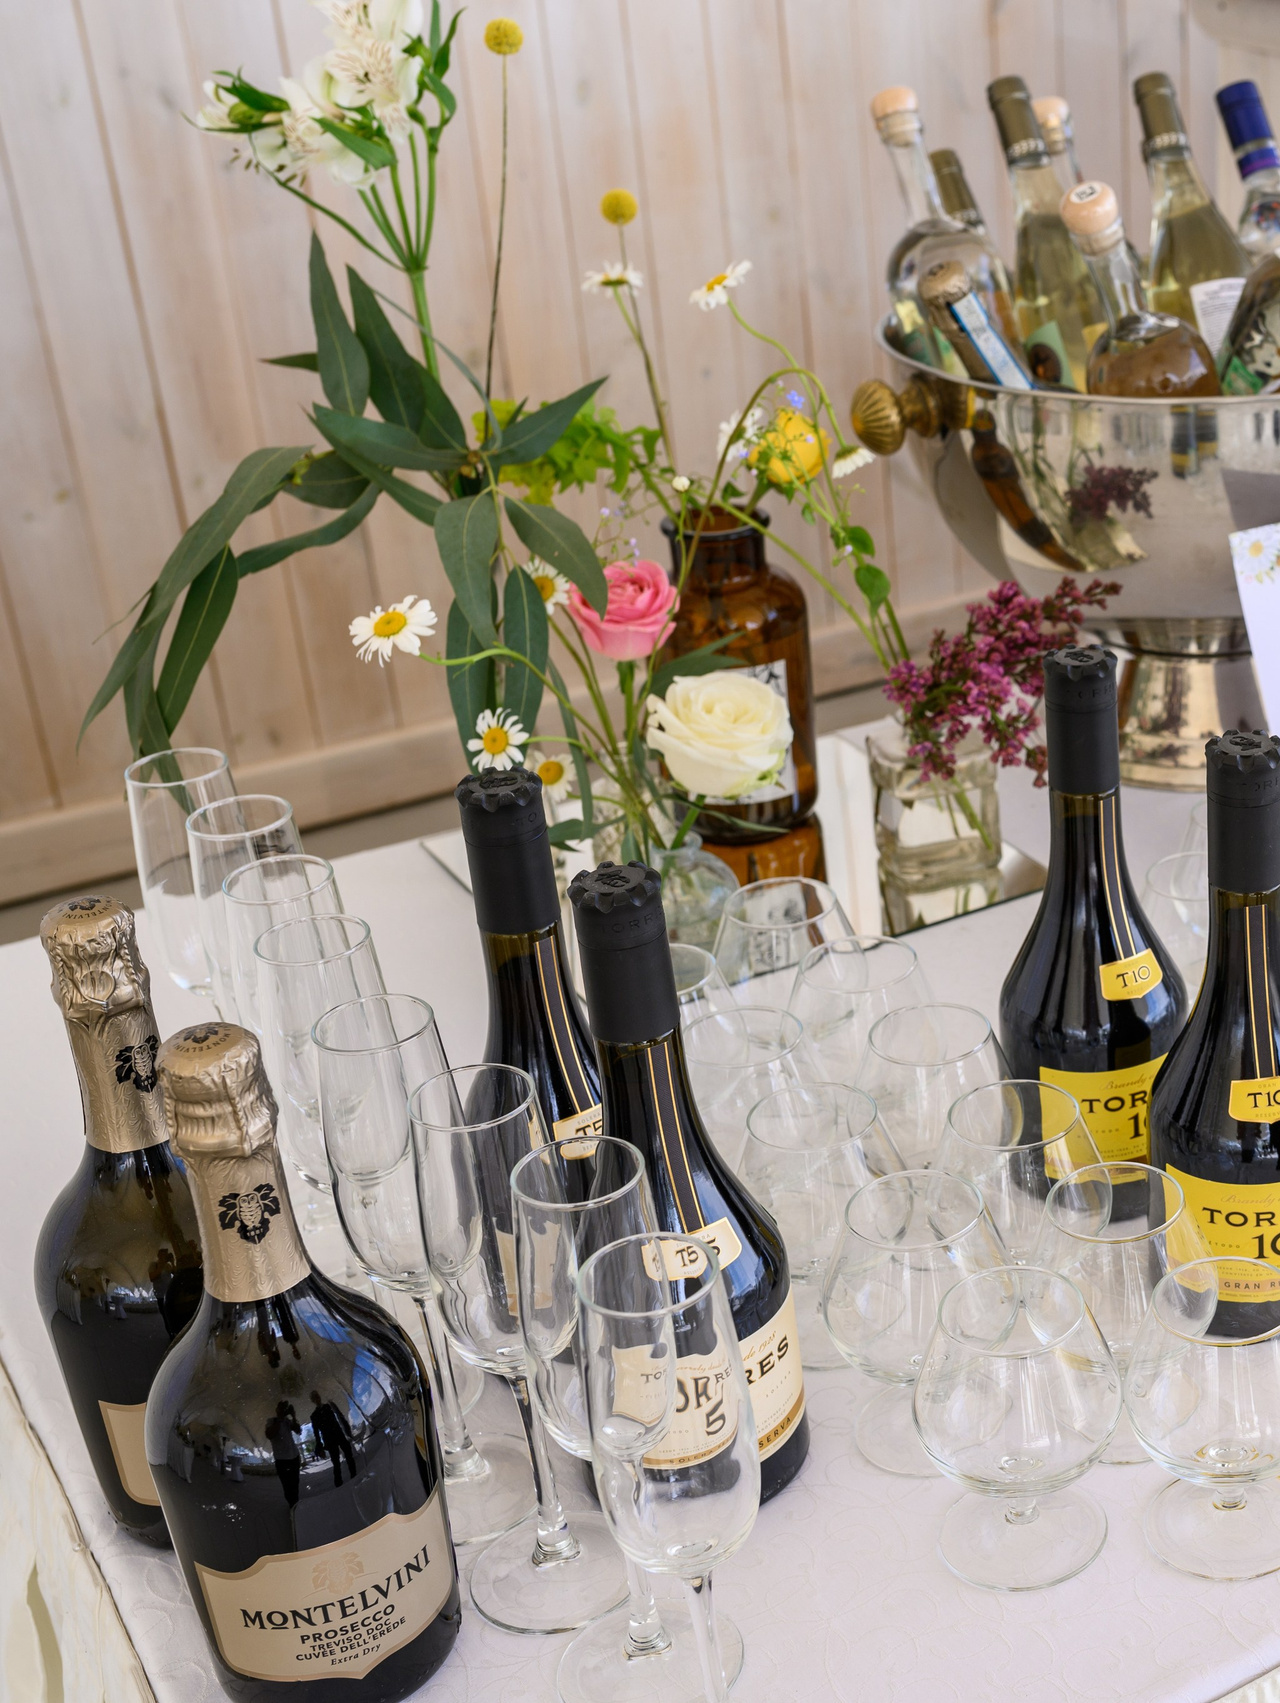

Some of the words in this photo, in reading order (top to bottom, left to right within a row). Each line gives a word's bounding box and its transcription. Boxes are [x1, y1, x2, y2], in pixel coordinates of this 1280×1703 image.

[1223, 1281, 1261, 1290] GRAN
[240, 1544, 431, 1630] MONTELVINI
[300, 1603, 395, 1645] PROSECCO
[310, 1633, 363, 1652] TREVISO
[366, 1617, 392, 1636] DOC
[340, 1616, 407, 1653] DELL'EREDE
[330, 1653, 359, 1666] Extra
[362, 1643, 381, 1656] Dry
